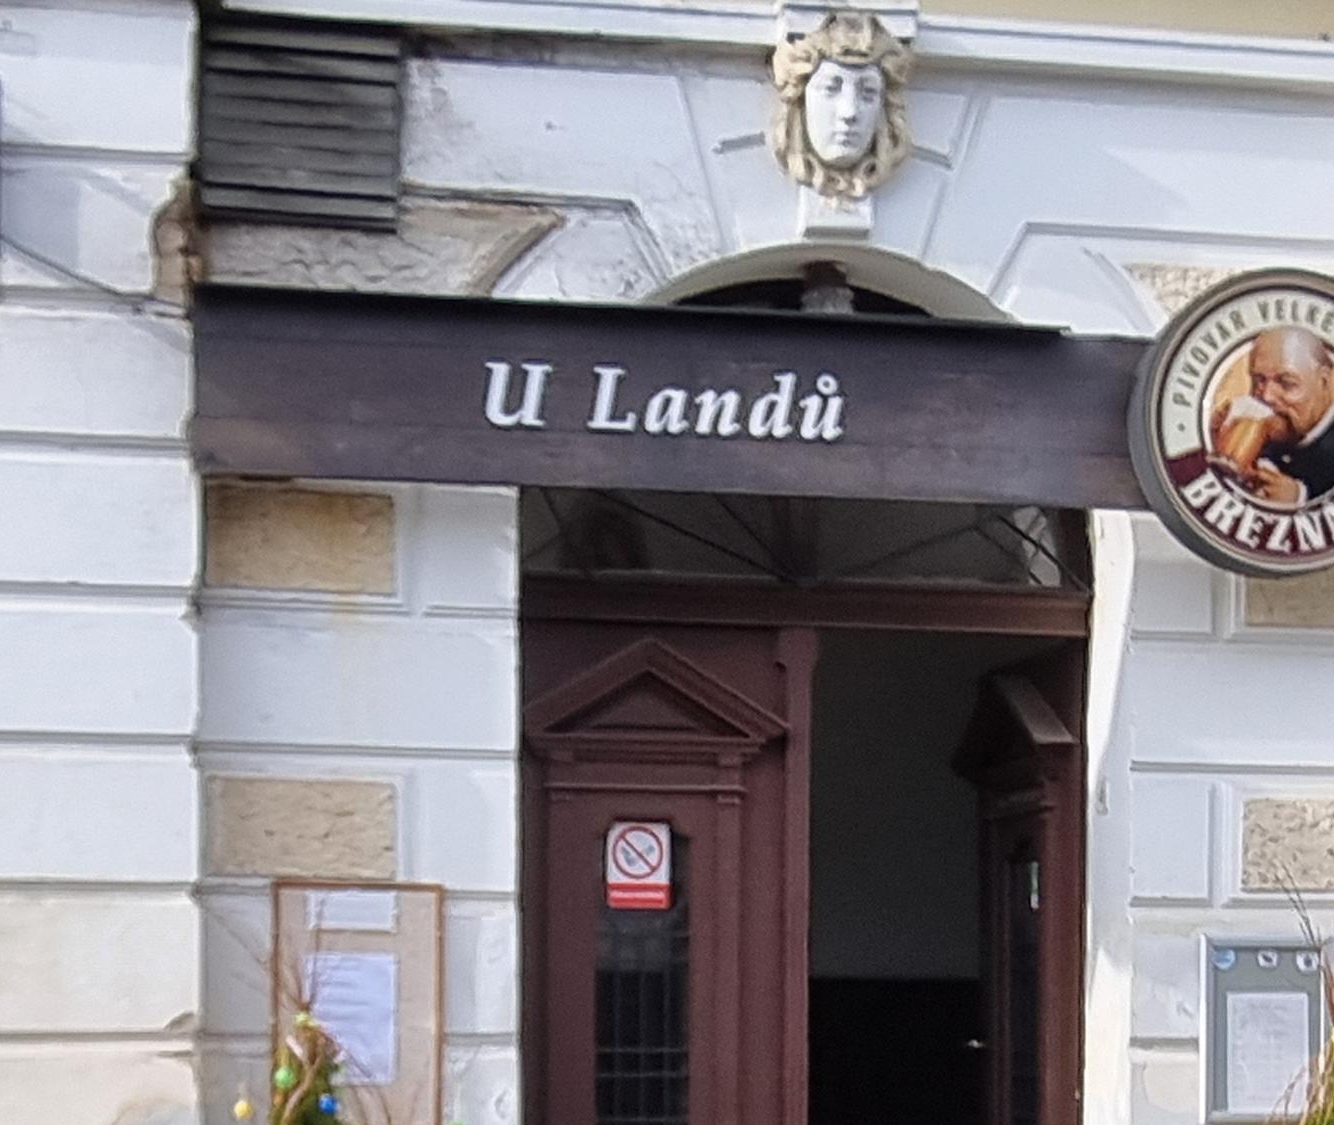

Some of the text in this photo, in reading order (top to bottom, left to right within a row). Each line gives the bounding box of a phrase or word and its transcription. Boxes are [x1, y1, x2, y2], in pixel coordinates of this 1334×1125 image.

[483, 360, 845, 442] U Landů
[1171, 309, 1246, 408] PIVOVAR
